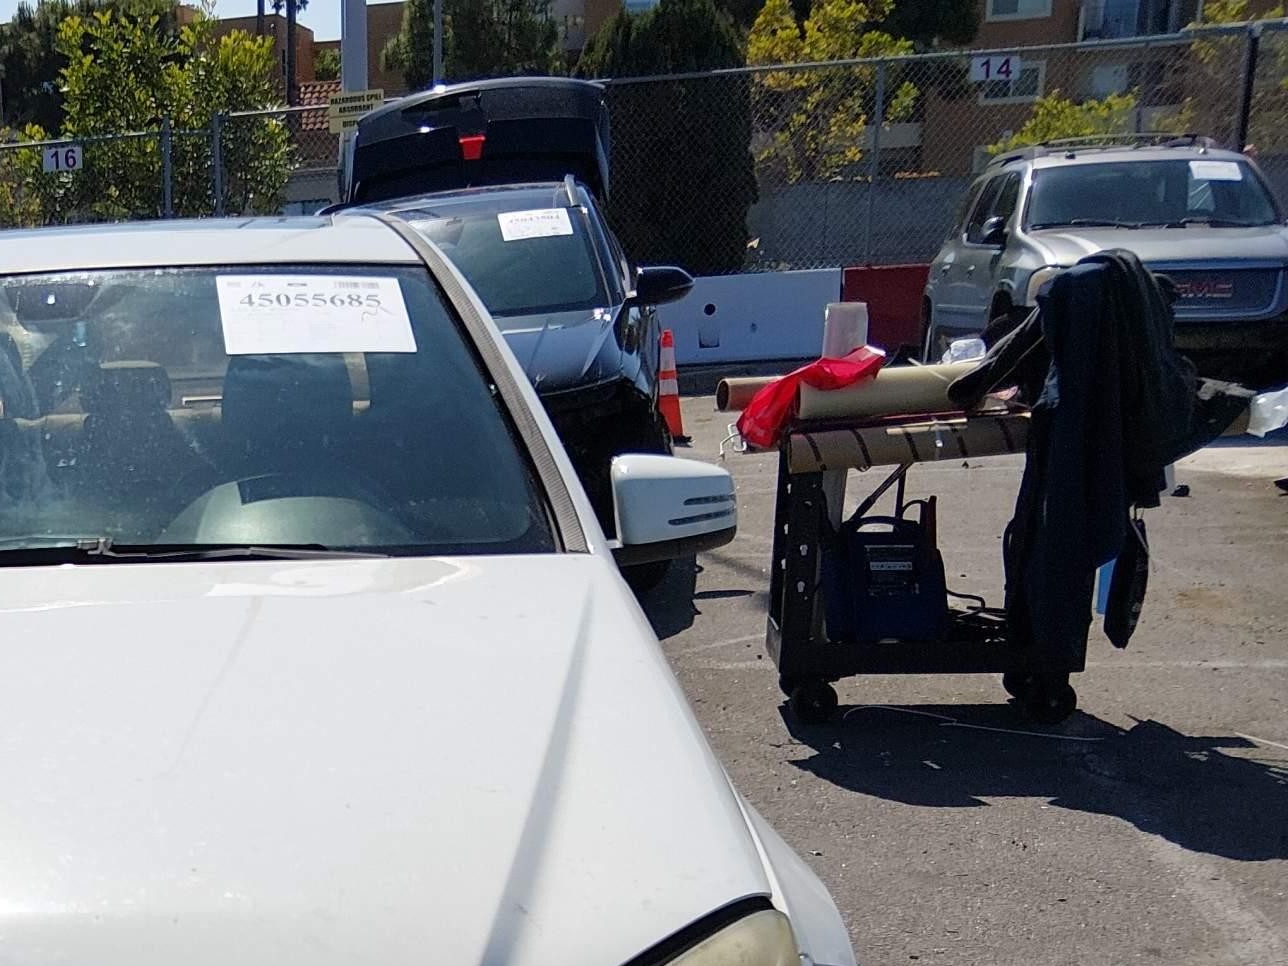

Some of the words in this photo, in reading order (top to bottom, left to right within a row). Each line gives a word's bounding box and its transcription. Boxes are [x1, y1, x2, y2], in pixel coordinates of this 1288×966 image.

[980, 57, 1012, 78] 14
[50, 149, 77, 169] 16
[240, 294, 381, 307] 45055685
